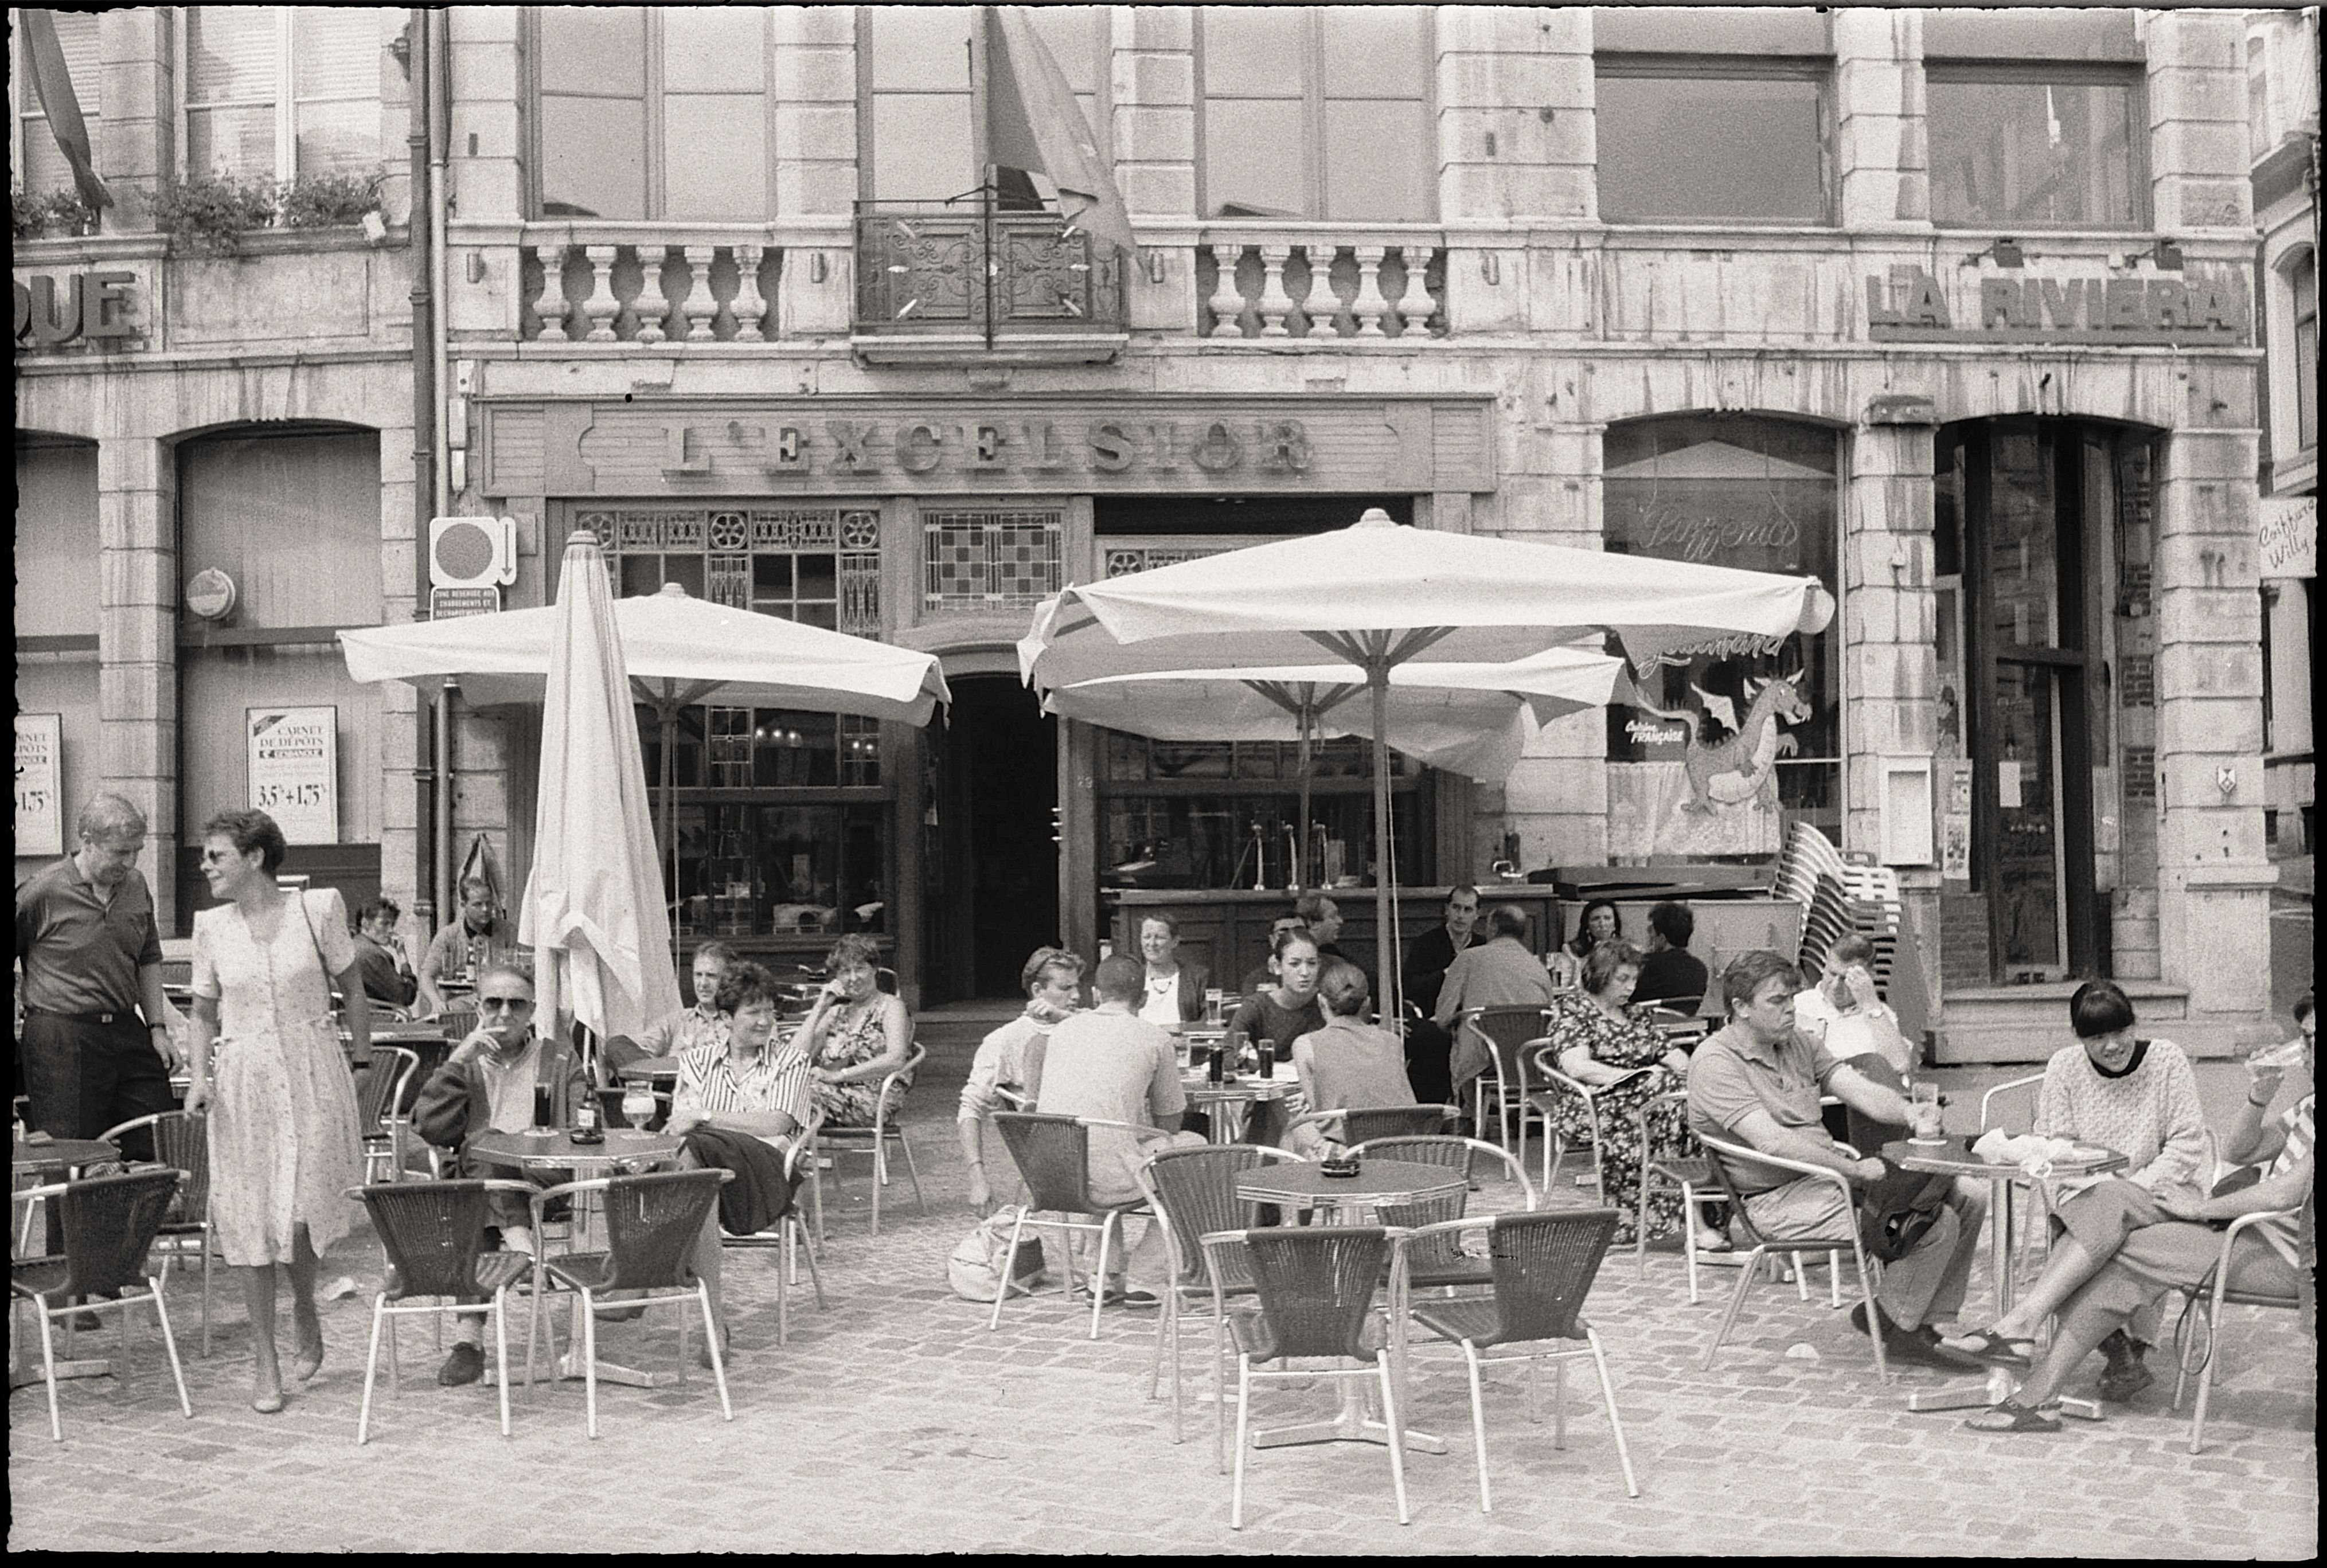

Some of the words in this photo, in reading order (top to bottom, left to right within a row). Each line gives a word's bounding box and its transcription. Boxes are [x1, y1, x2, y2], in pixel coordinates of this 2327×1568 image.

[1865, 272, 1951, 328] LA
[1981, 276, 2239, 331] RIVIERA
[662, 419, 1314, 476] L'EXCELSIOR
[2269, 538, 2309, 569] Willy
